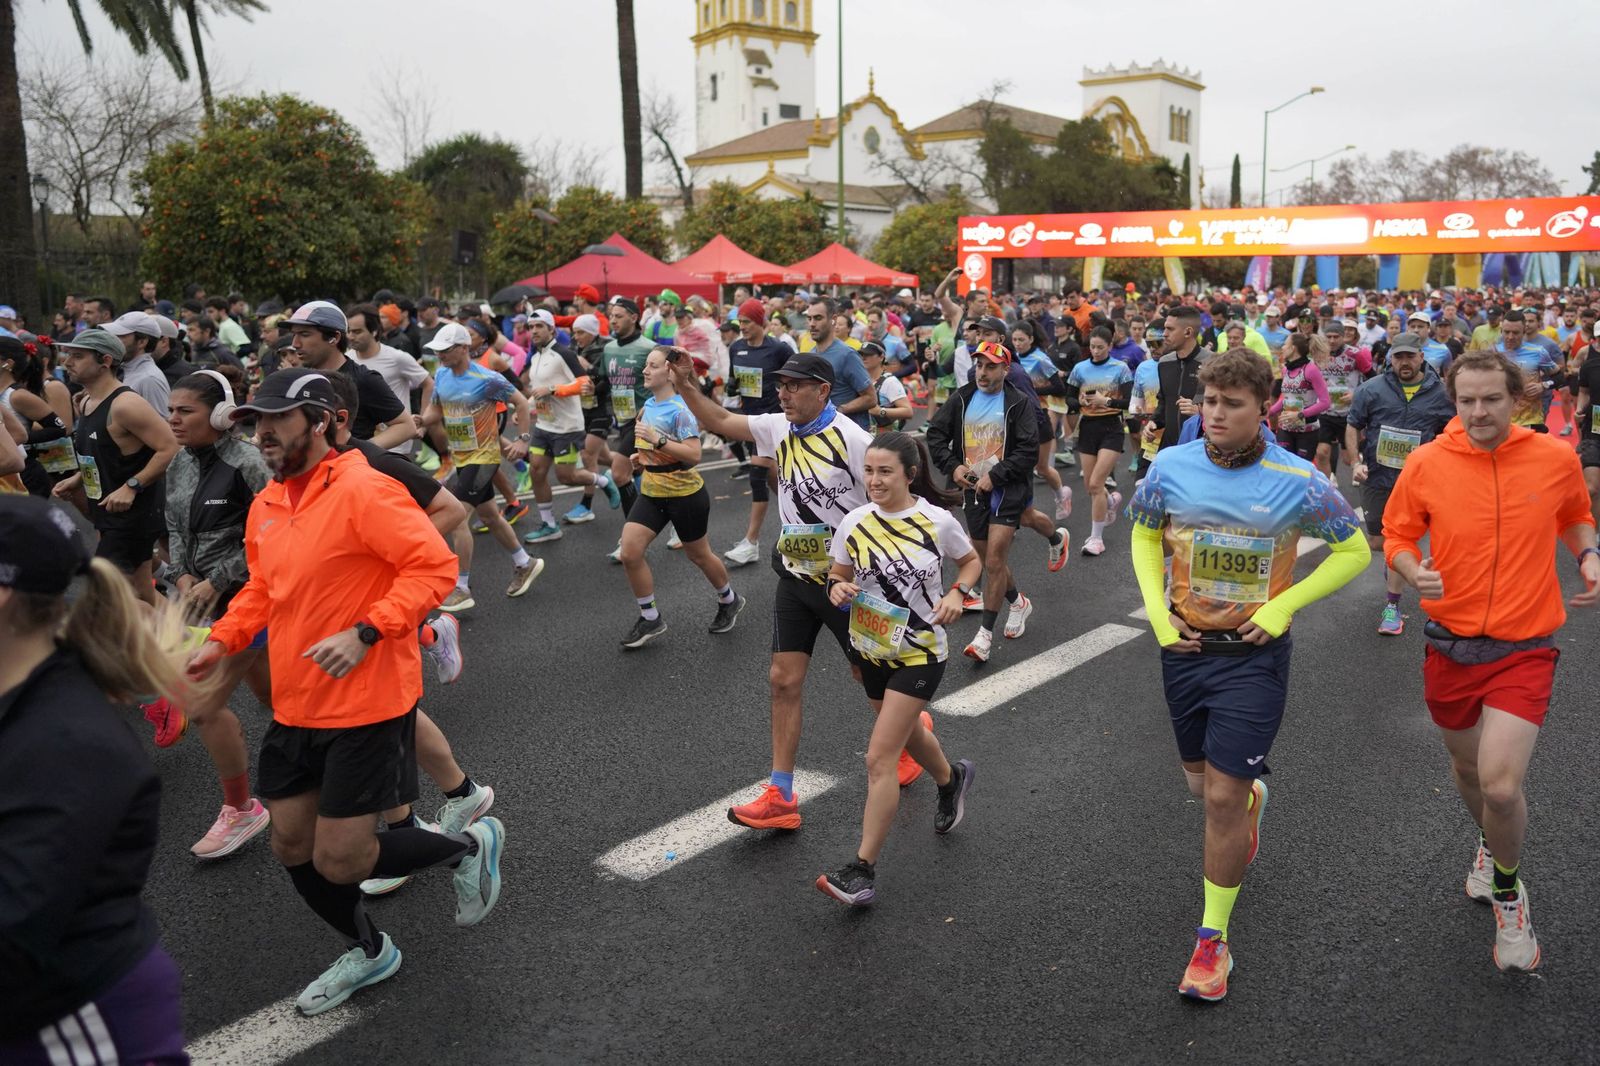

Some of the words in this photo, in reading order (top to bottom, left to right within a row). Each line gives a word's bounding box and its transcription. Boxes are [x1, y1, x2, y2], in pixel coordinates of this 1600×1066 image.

[799, 477, 853, 510] Sergio
[784, 538, 819, 554] 8439
[1199, 548, 1259, 575] 11393
[885, 559, 937, 590] Sergio
[856, 606, 891, 637] 8366
